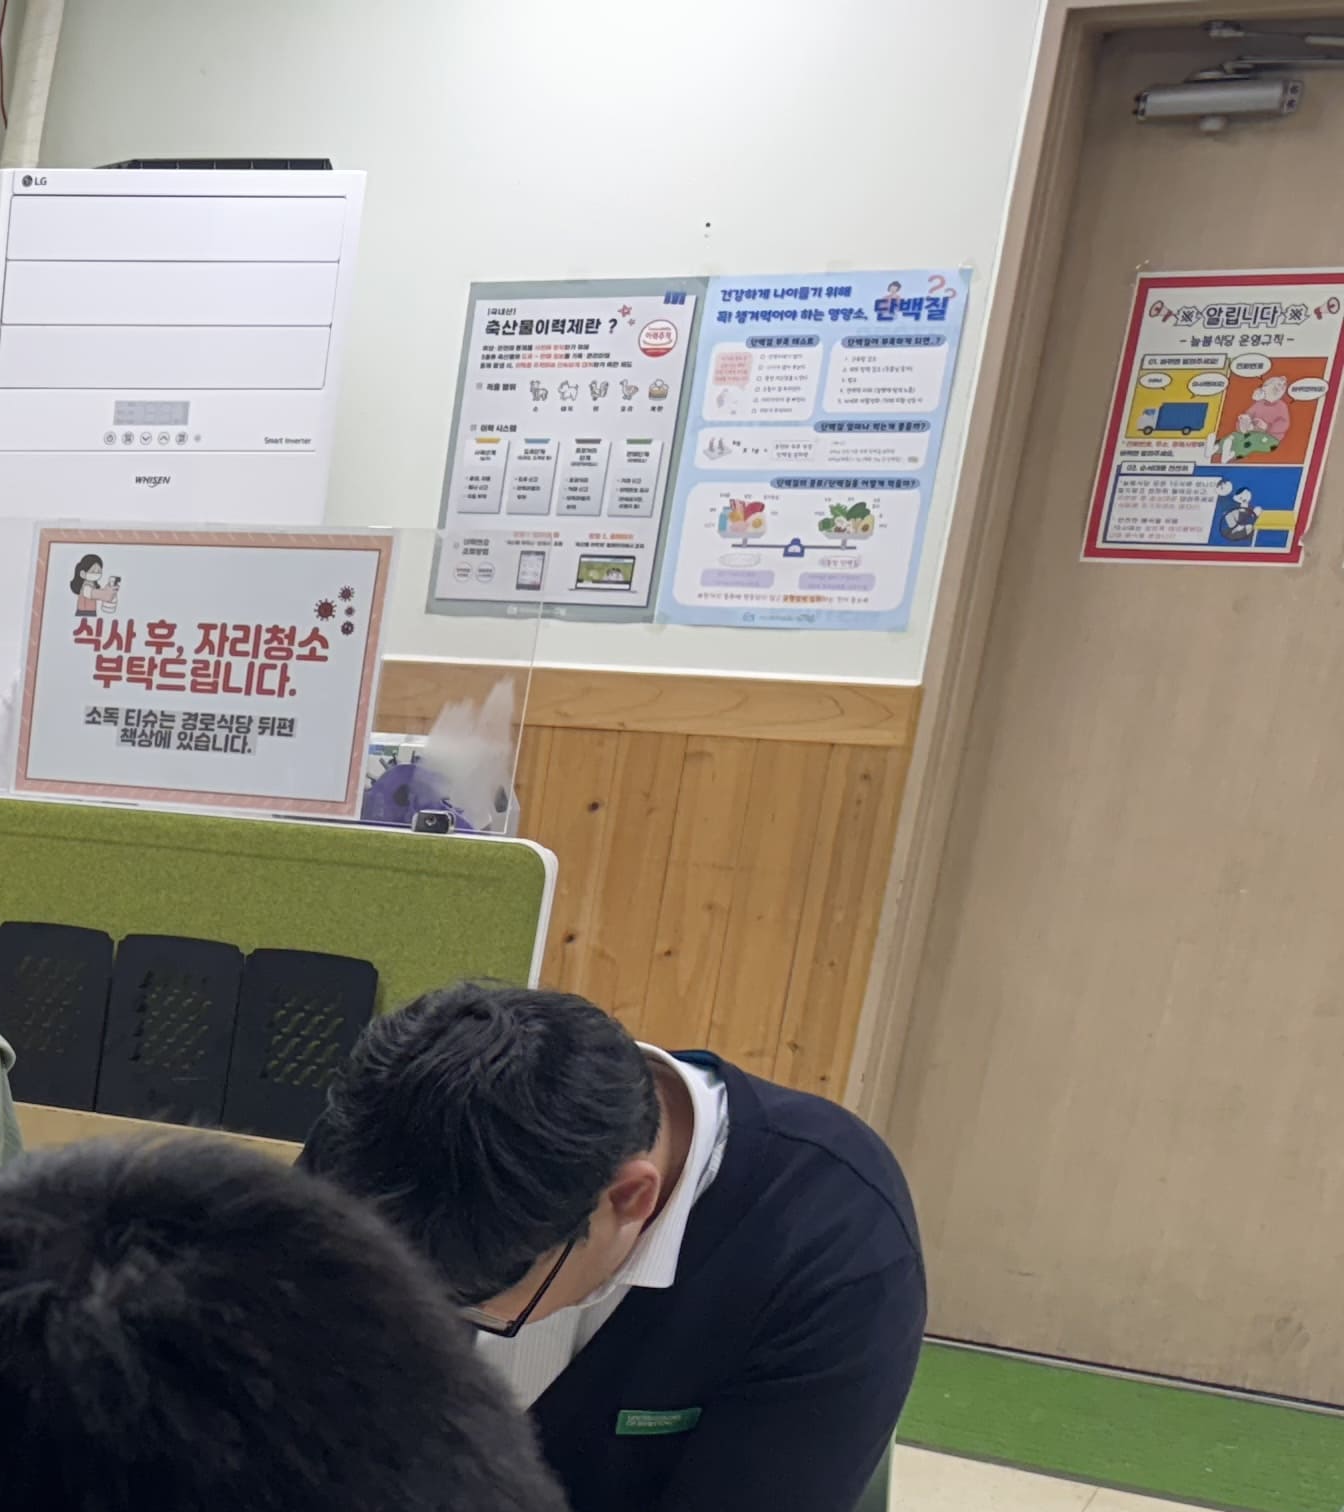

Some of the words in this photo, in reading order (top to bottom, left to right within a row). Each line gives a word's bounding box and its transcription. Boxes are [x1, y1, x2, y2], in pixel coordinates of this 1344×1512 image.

[34, 176, 47, 186] LG
[721, 288, 770, 302] 건강하게
[774, 286, 823, 300] 나이들기
[826, 286, 852, 298] 위해
[717, 311, 732, 323] 꼭!
[735, 309, 797, 324] 챙겨먹어야
[800, 308, 825, 321] 하는
[828, 308, 868, 322] 영양소,
[874, 296, 950, 321] 단백질
[1206, 306, 1279, 326] 알립니다
[485, 319, 601, 336] 축산물이력제란
[609, 319, 618, 334] ?
[750, 338, 773, 347] 단백질
[792, 337, 814, 346] 테스트
[1190, 335, 1235, 347] 늘봄식당
[1239, 334, 1285, 346] 운영규칙
[264, 436, 283, 444] Smart
[135, 476, 171, 488] WHISEN
[73, 618, 136, 653] 식사
[144, 620, 184, 658] 후,
[193, 622, 330, 662] 자리청소
[93, 654, 298, 698] 부탁드립니다.
[85, 707, 119, 727] 소독
[124, 708, 176, 731] 티슈는
[181, 712, 253, 735] 경로식당
[257, 717, 295, 737] 뒤편
[120, 728, 171, 750] 책상에
[176, 730, 253, 754] 있습니다.
